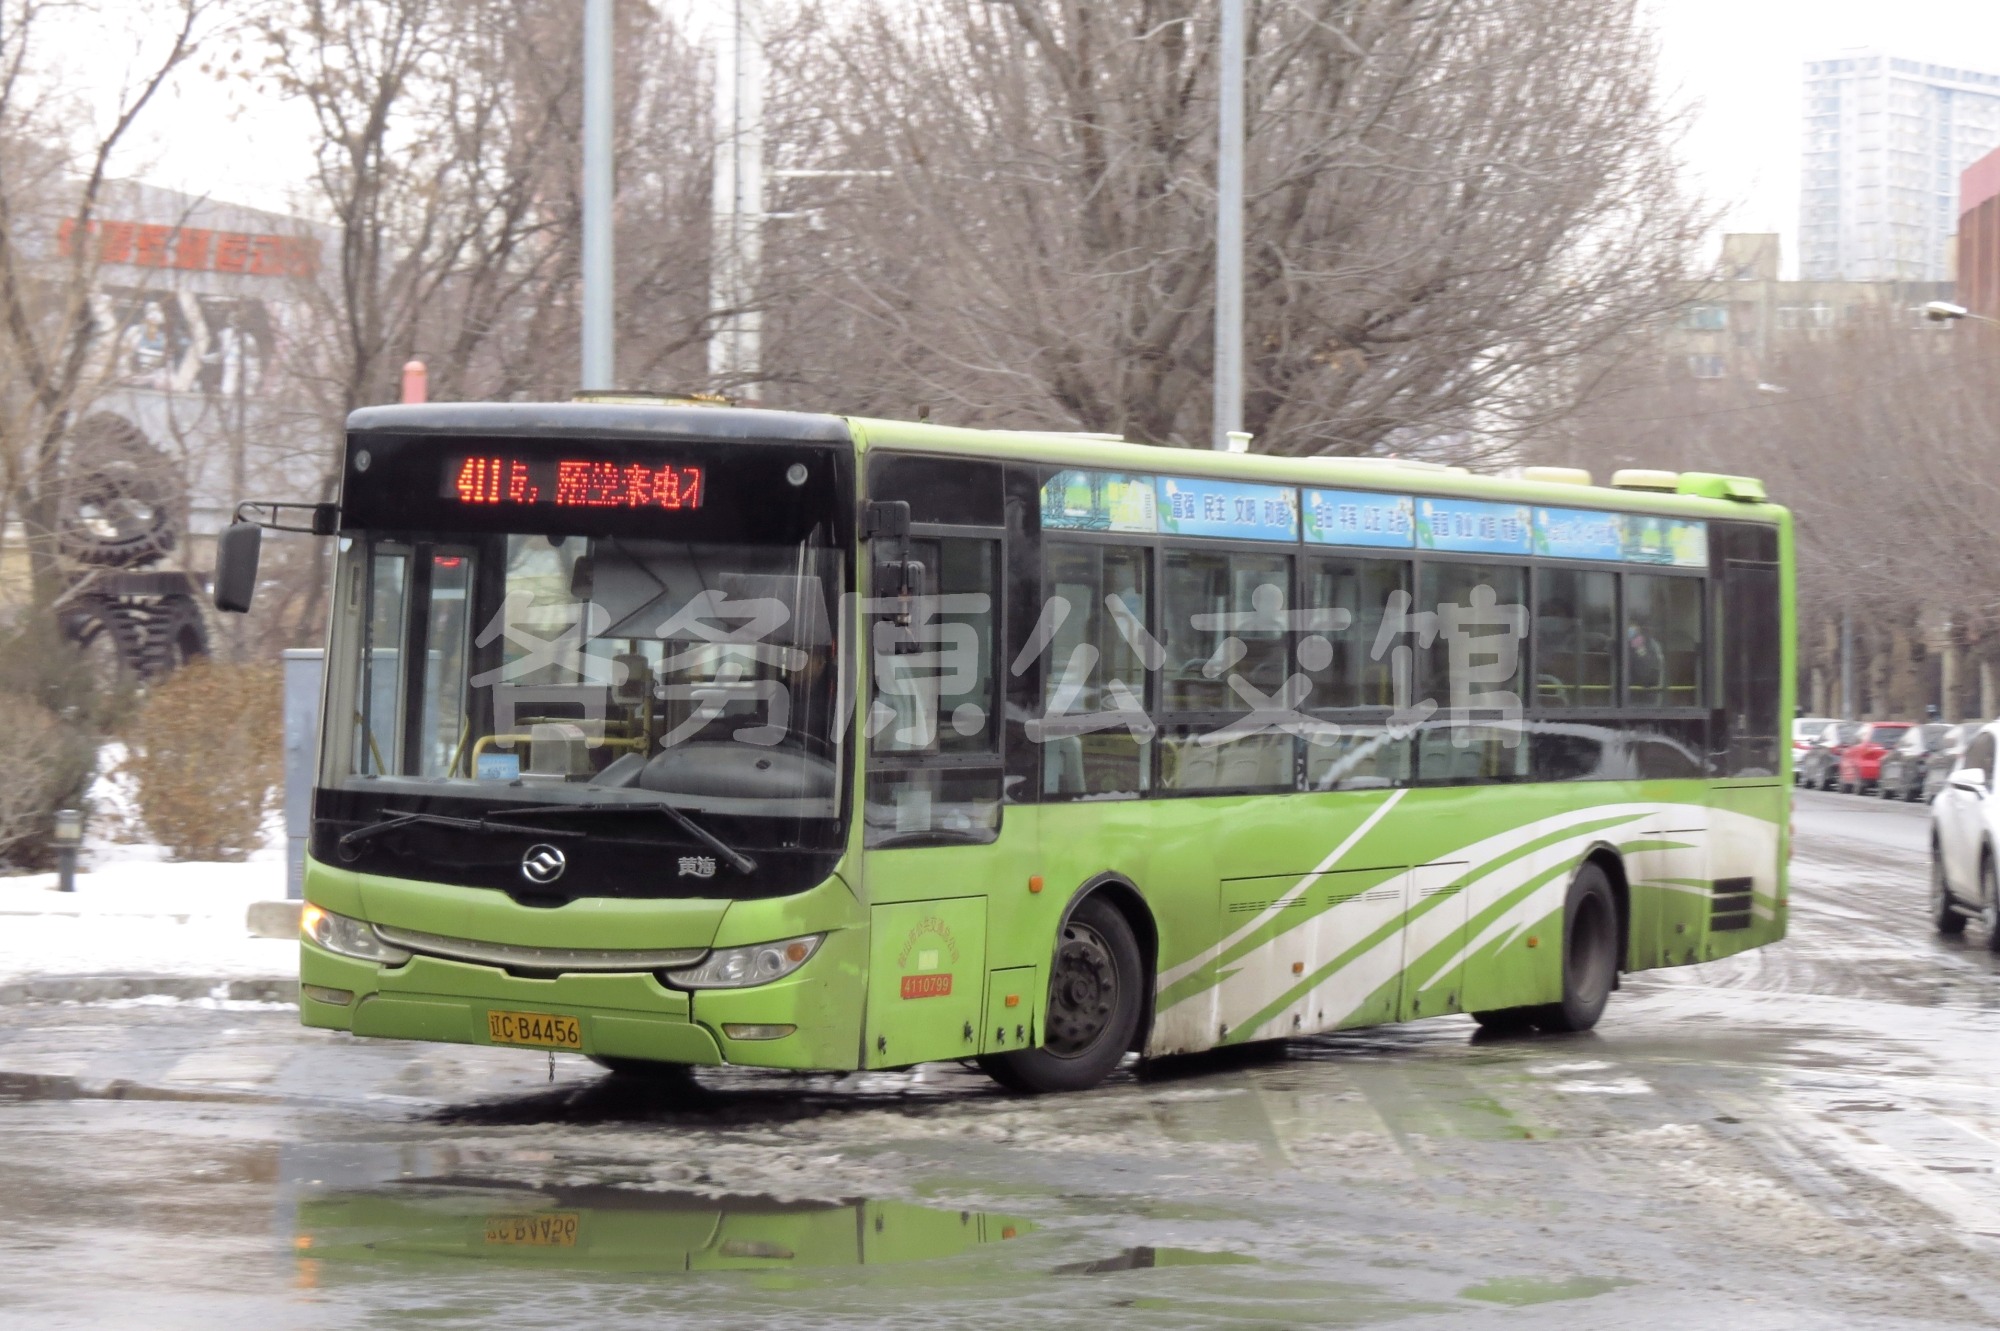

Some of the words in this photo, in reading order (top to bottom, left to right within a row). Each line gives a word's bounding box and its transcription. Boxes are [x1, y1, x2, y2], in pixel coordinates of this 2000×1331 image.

[1171, 492, 1195, 519] 富强
[1203, 494, 1226, 521] 民主
[1234, 497, 1256, 524] 文明
[677, 855, 717, 878] 黄海
[904, 977, 949, 993] 4110799
